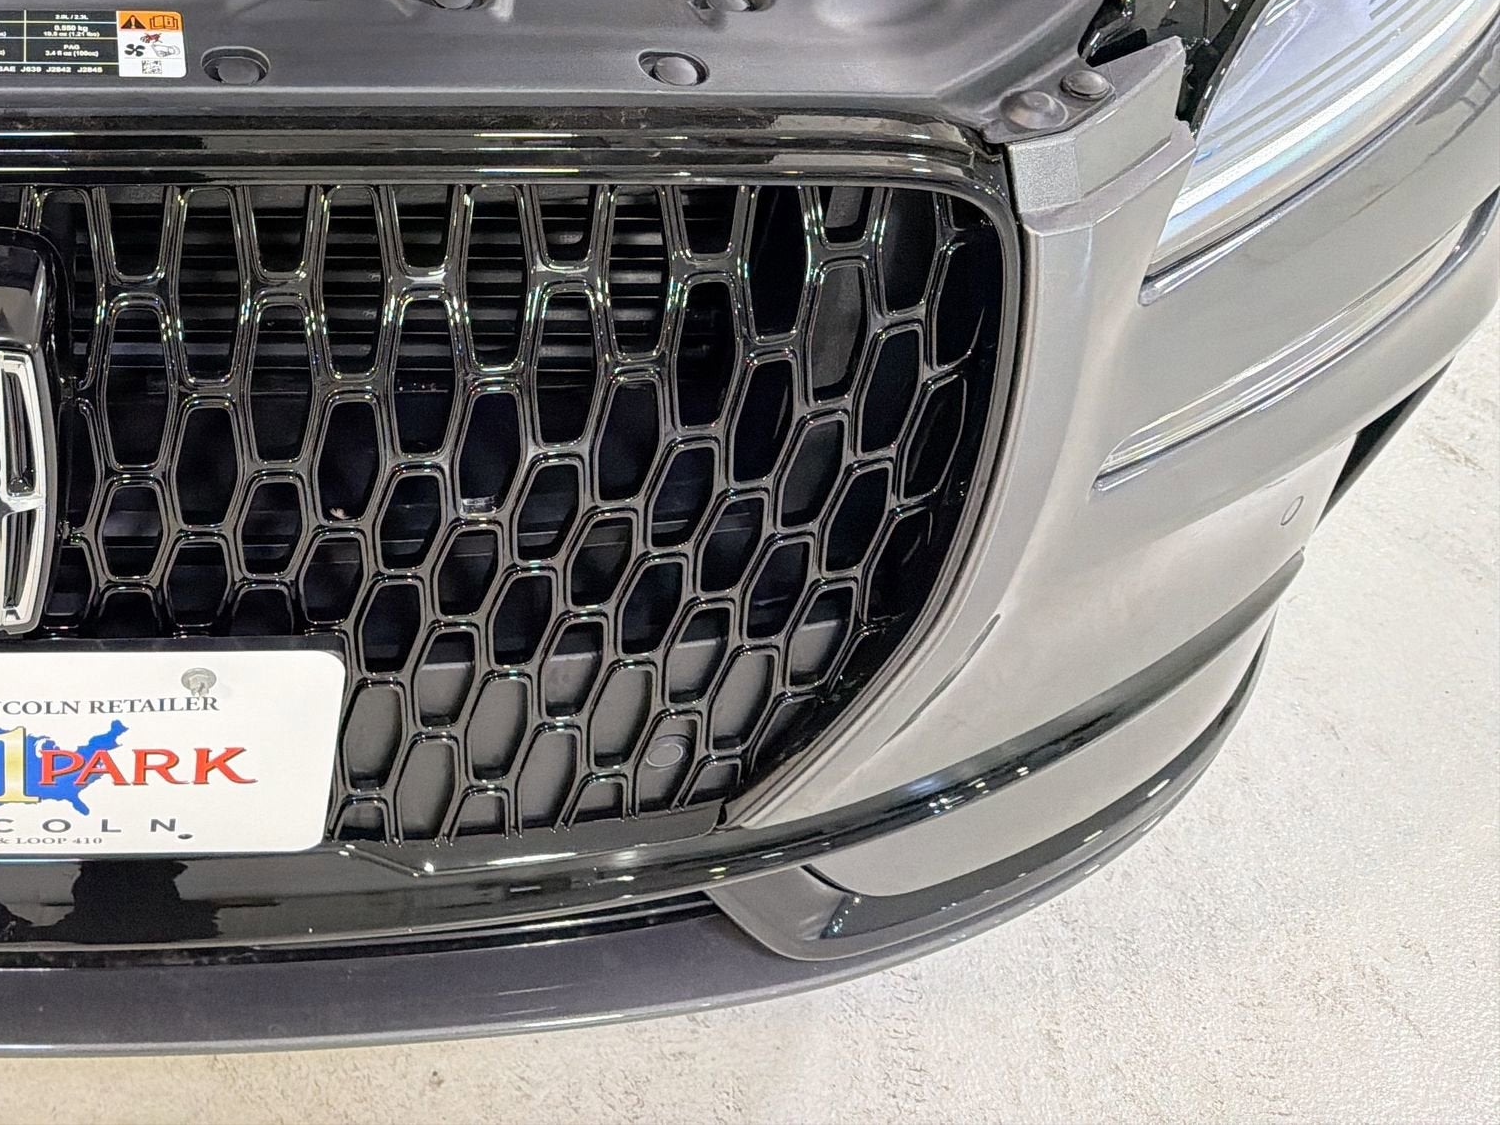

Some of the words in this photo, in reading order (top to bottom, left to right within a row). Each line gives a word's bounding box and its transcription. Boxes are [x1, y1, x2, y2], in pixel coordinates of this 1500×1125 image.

[89, 696, 220, 715] RETAILER
[38, 747, 259, 786] PARK
[16, 837, 68, 845] LOOP
[72, 837, 103, 845] 410
